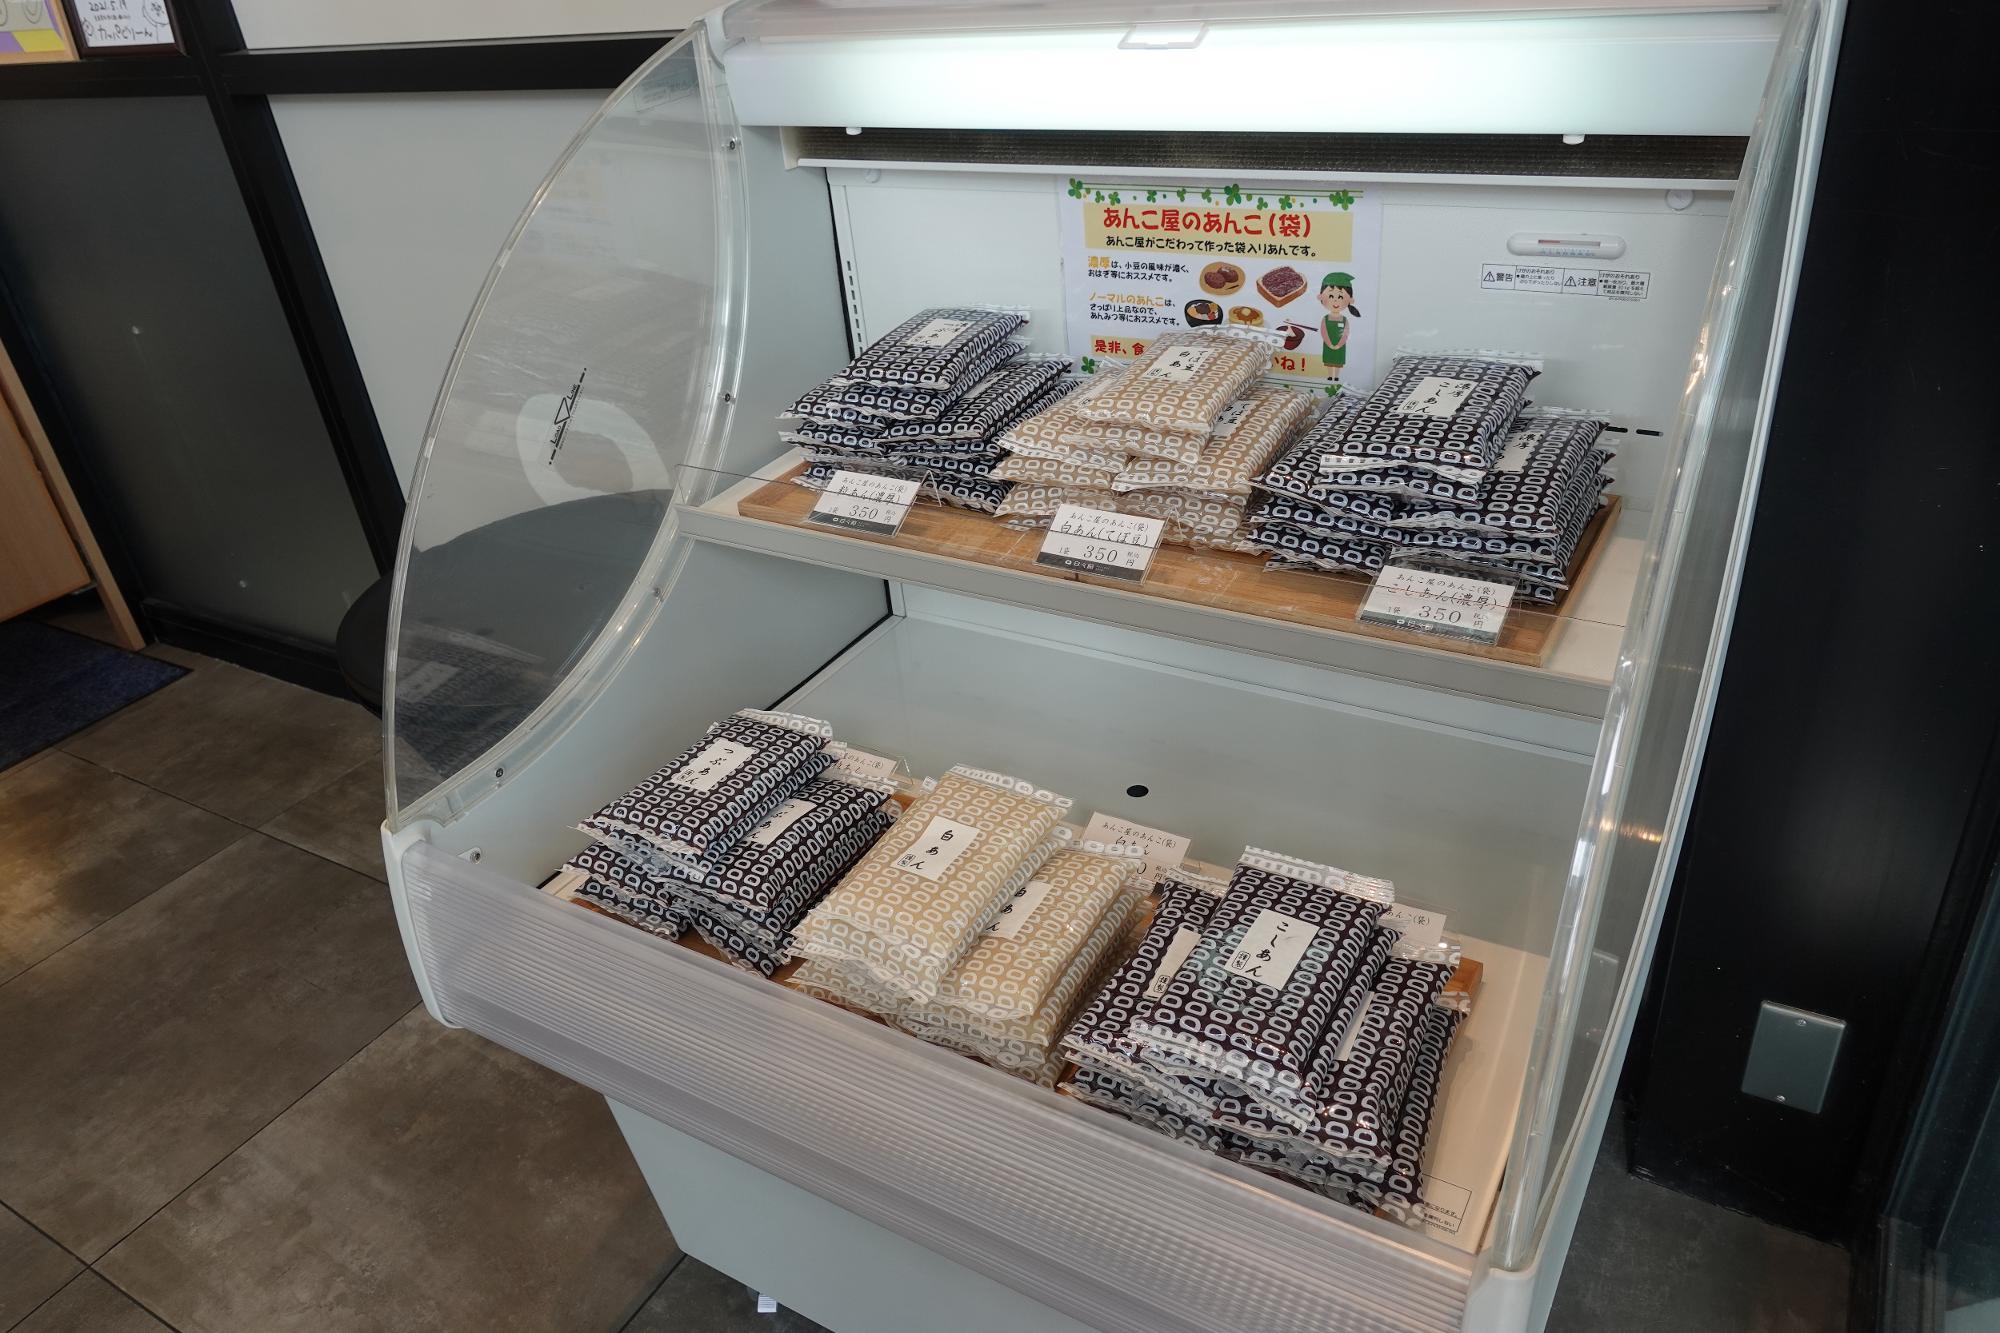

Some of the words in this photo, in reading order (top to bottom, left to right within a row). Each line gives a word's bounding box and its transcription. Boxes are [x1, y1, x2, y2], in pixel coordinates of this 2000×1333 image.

[1103, 207, 1311, 238] あんこ屋のあんこ(袋)
[1105, 235, 1316, 257] あんこ屋がこだわって作った袋入りあんです。
[1577, 276, 1597, 287] 注意
[1089, 292, 1176, 307] ノーマルのあんこは、
[848, 504, 879, 520] 350
[1083, 544, 1118, 563] 350
[1397, 573, 1496, 596] あんこ屋のあんこ(袋)
[1418, 605, 1462, 624] 350
[909, 829, 954, 870] 白あん
[985, 886, 1027, 932] 白あん
[1244, 920, 1290, 978] こしあん
